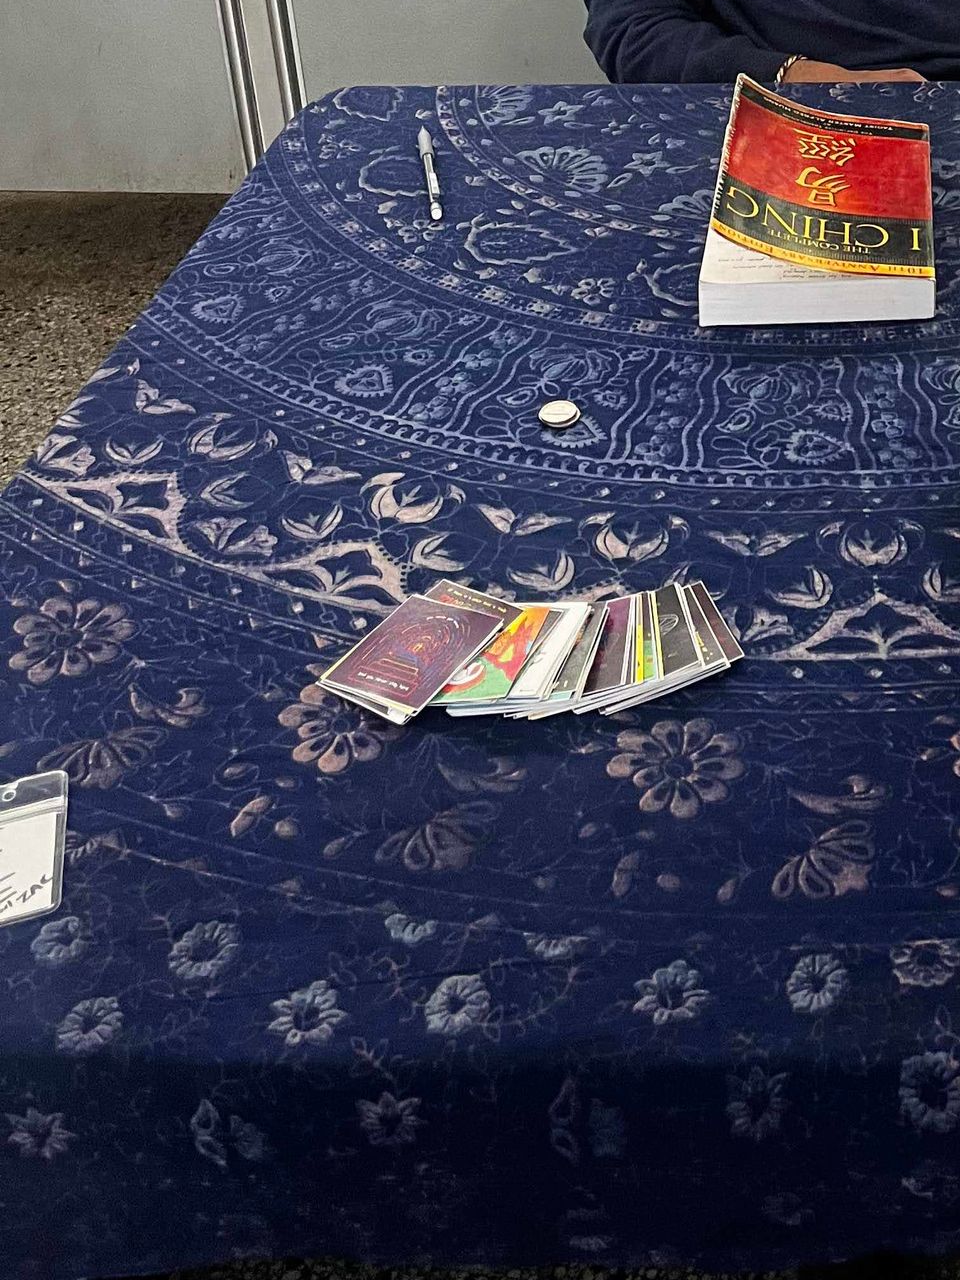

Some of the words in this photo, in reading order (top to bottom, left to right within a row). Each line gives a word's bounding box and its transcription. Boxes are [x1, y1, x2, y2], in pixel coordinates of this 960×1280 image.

[726, 186, 889, 248] CHING
[767, 228, 839, 251] COMPLETE
[843, 245, 870, 254] THE
[911, 228, 921, 251] I
[781, 249, 880, 272] ANNIVERSARY
